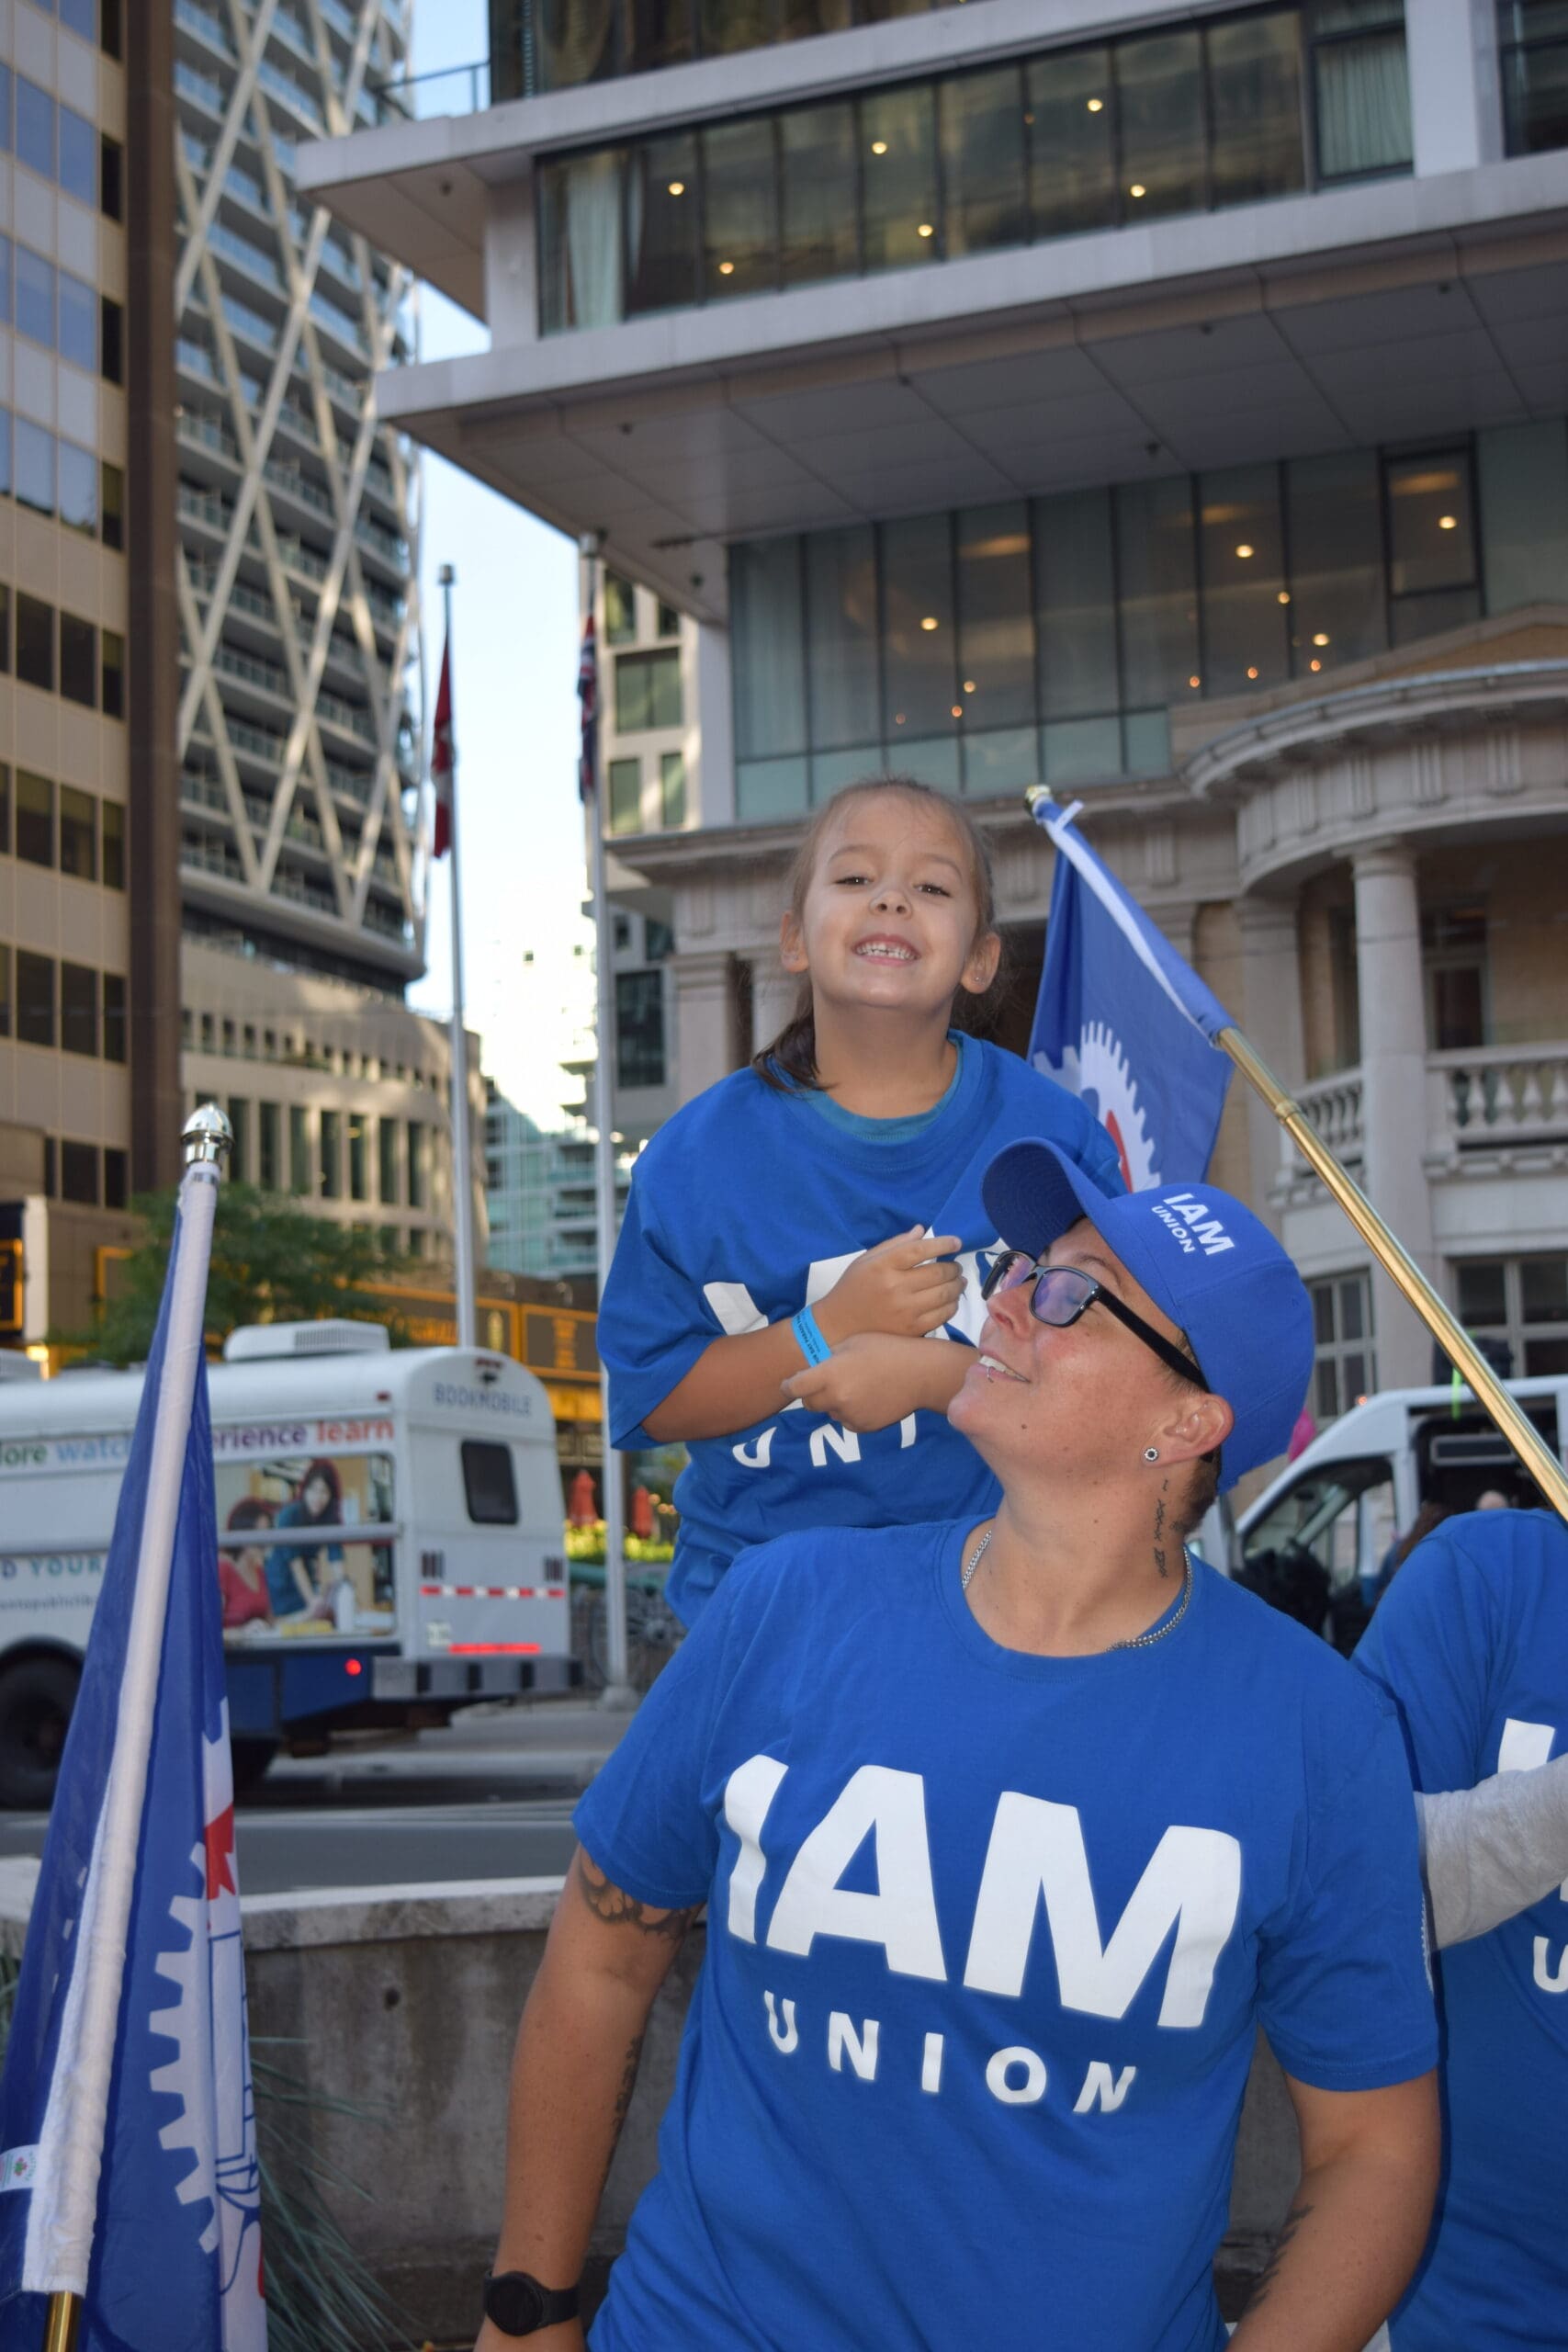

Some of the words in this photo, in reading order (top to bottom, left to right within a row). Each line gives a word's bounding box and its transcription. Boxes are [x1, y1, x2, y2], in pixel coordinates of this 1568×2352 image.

[1151, 1205, 1196, 1253] UNION
[1163, 1193, 1235, 1256] IAM
[434, 1381, 531, 1417] BOOKMOBILE
[56, 1436, 127, 1464] watc
[316, 1419, 395, 1442] learn
[732, 1411, 917, 1468] UNI
[28, 1556, 104, 1577] YOUR
[724, 1754, 1242, 2028] IAM
[763, 1989, 1137, 2114] UNION
